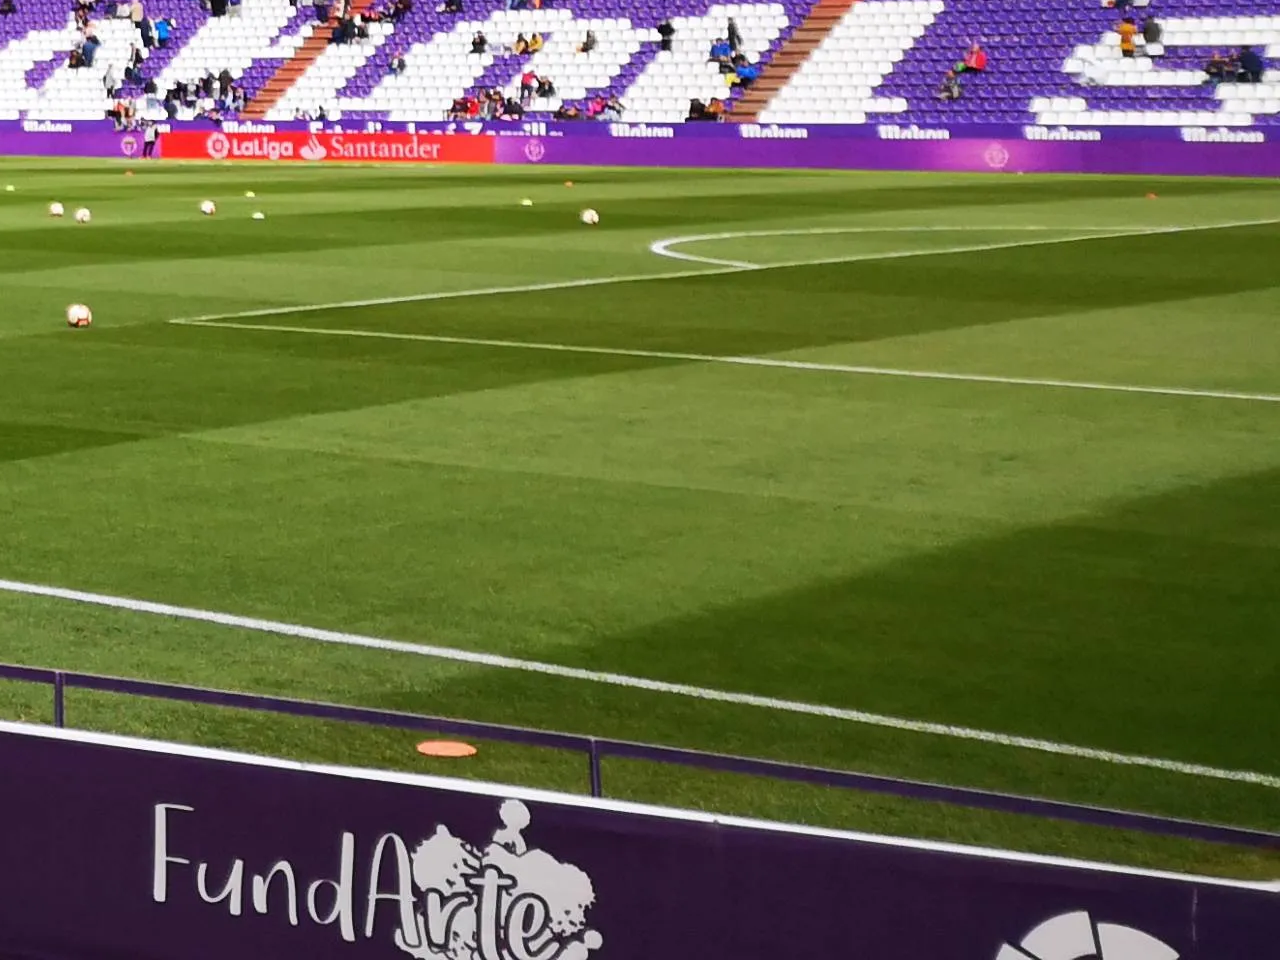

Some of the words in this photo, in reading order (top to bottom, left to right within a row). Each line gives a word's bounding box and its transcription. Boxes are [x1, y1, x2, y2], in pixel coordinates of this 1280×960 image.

[232, 138, 293, 160] LaLiga
[331, 136, 441, 160] Santander
[153, 803, 558, 960] FundArte
